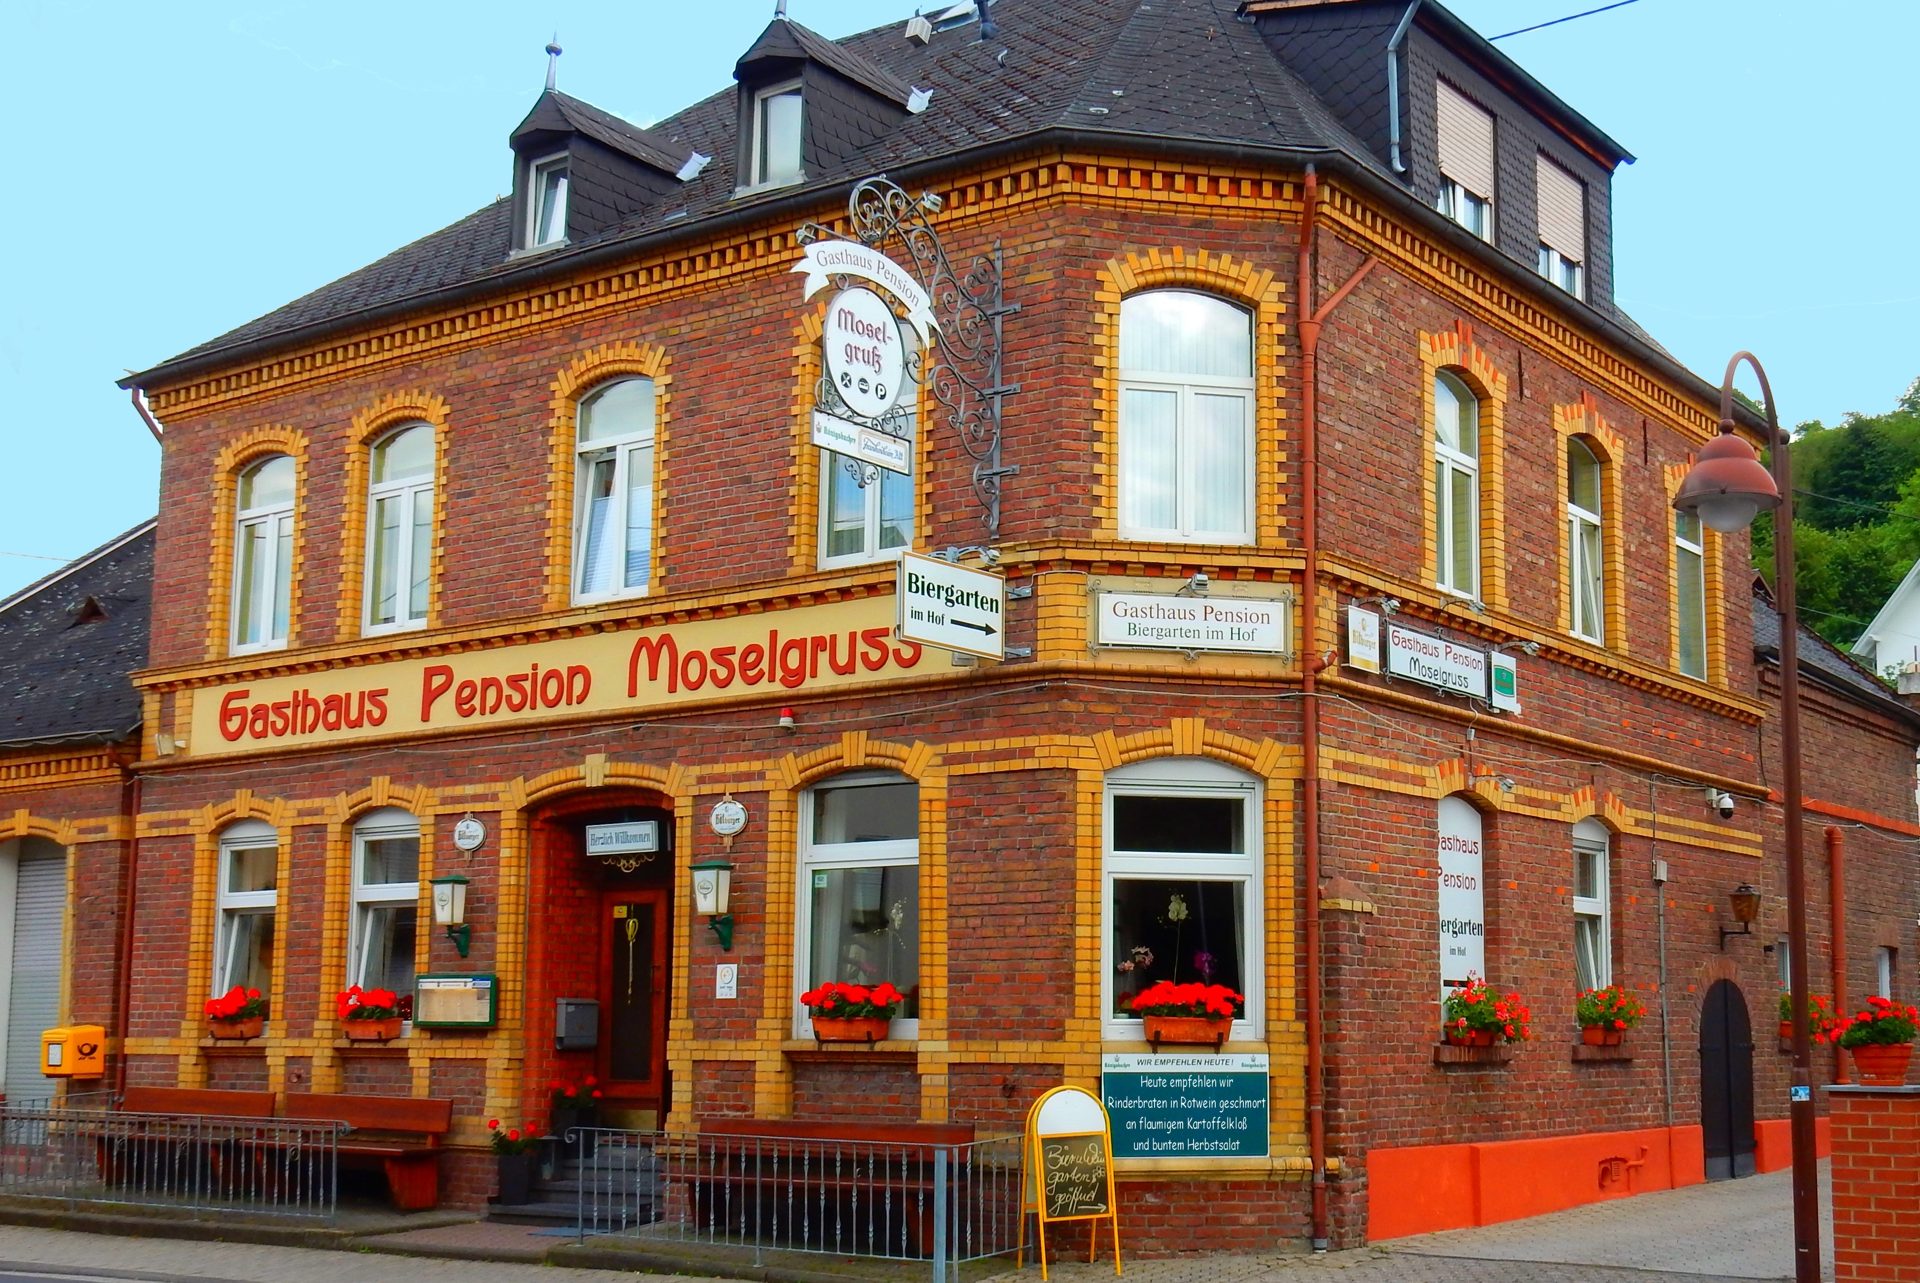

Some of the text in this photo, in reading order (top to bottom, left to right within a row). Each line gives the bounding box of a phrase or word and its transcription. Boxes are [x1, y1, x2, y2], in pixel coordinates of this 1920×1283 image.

[816, 249, 920, 307] Gasthaus Pension
[837, 307, 893, 346] Mosel-
[844, 340, 882, 375] gruß
[907, 572, 1000, 614] Biergarten
[910, 607, 945, 626] im Hof
[1112, 601, 1272, 625] Gasthaus Pension
[1127, 622, 1258, 642] Biergarten im Hof
[1391, 629, 1483, 672] Gasthaus Pension
[1409, 656, 1469, 689] Moselgruss
[219, 627, 923, 741] Gasthaus Pension Moselgruss
[1438, 834, 1479, 855] asthaus
[1449, 945, 1456, 956] im
[1154, 1058, 1202, 1066] EMPFEHLEN
[1140, 1075, 1234, 1092] Heute empfehlen wir
[1108, 1097, 1266, 1113] Rinderbraten in Rotwein geschmort
[1126, 1117, 1248, 1134] an flaumigem Kartoffelkloß
[1133, 1138, 1240, 1151] und buntem Herbstsalat
